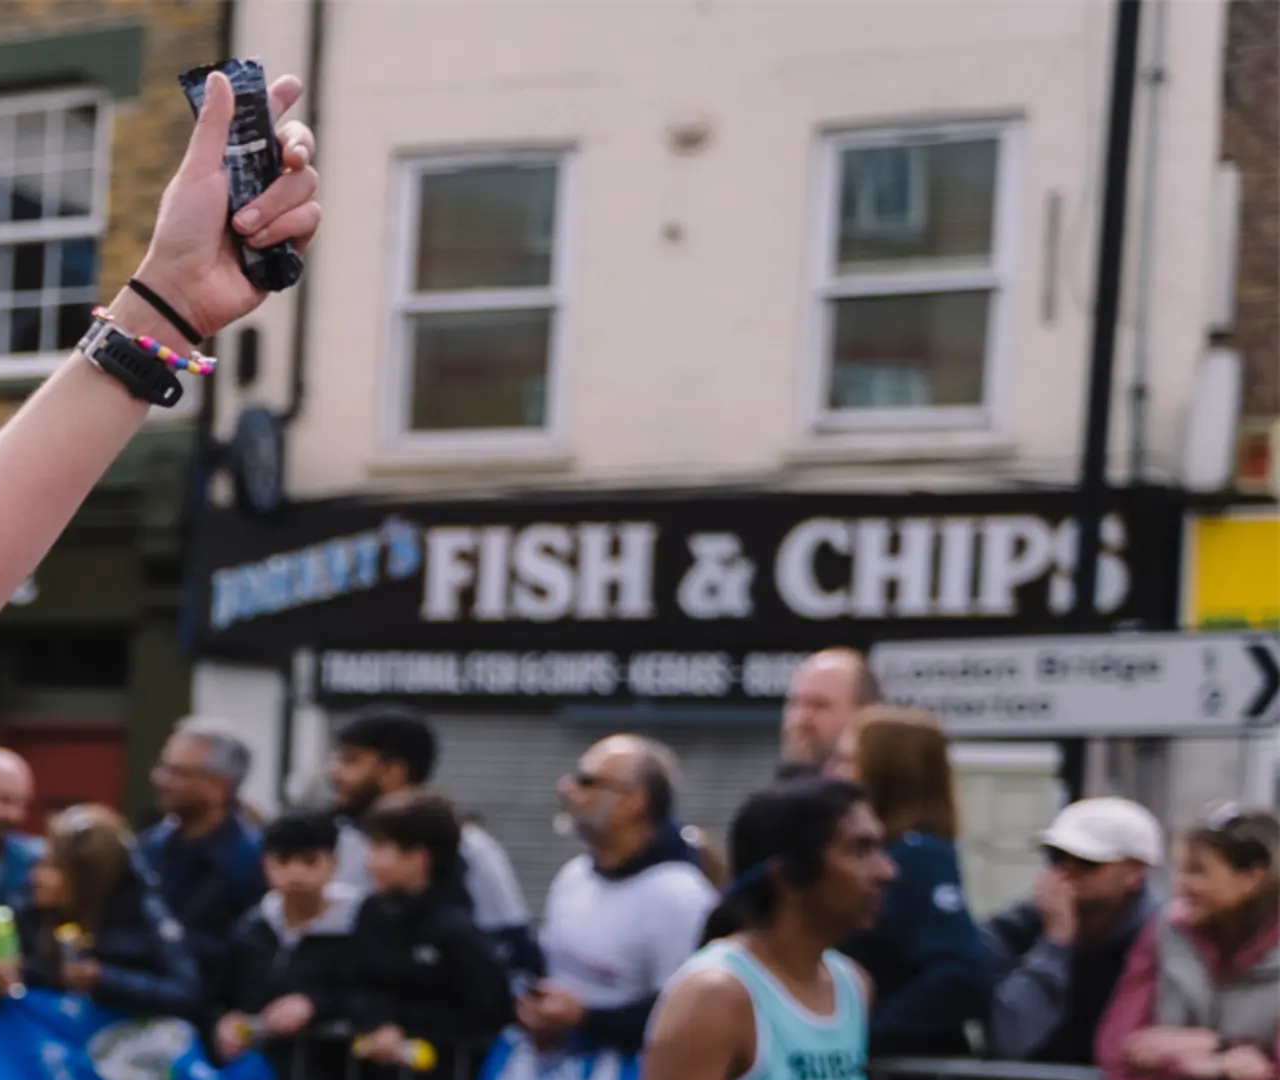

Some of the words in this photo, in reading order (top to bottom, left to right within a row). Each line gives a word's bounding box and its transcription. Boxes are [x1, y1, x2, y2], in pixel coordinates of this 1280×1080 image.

[421, 524, 657, 623] FISH
[676, 532, 755, 619] &
[773, 514, 1130, 619] CHIPS
[883, 656, 1018, 681] London
[1036, 654, 1163, 687] Bridge
